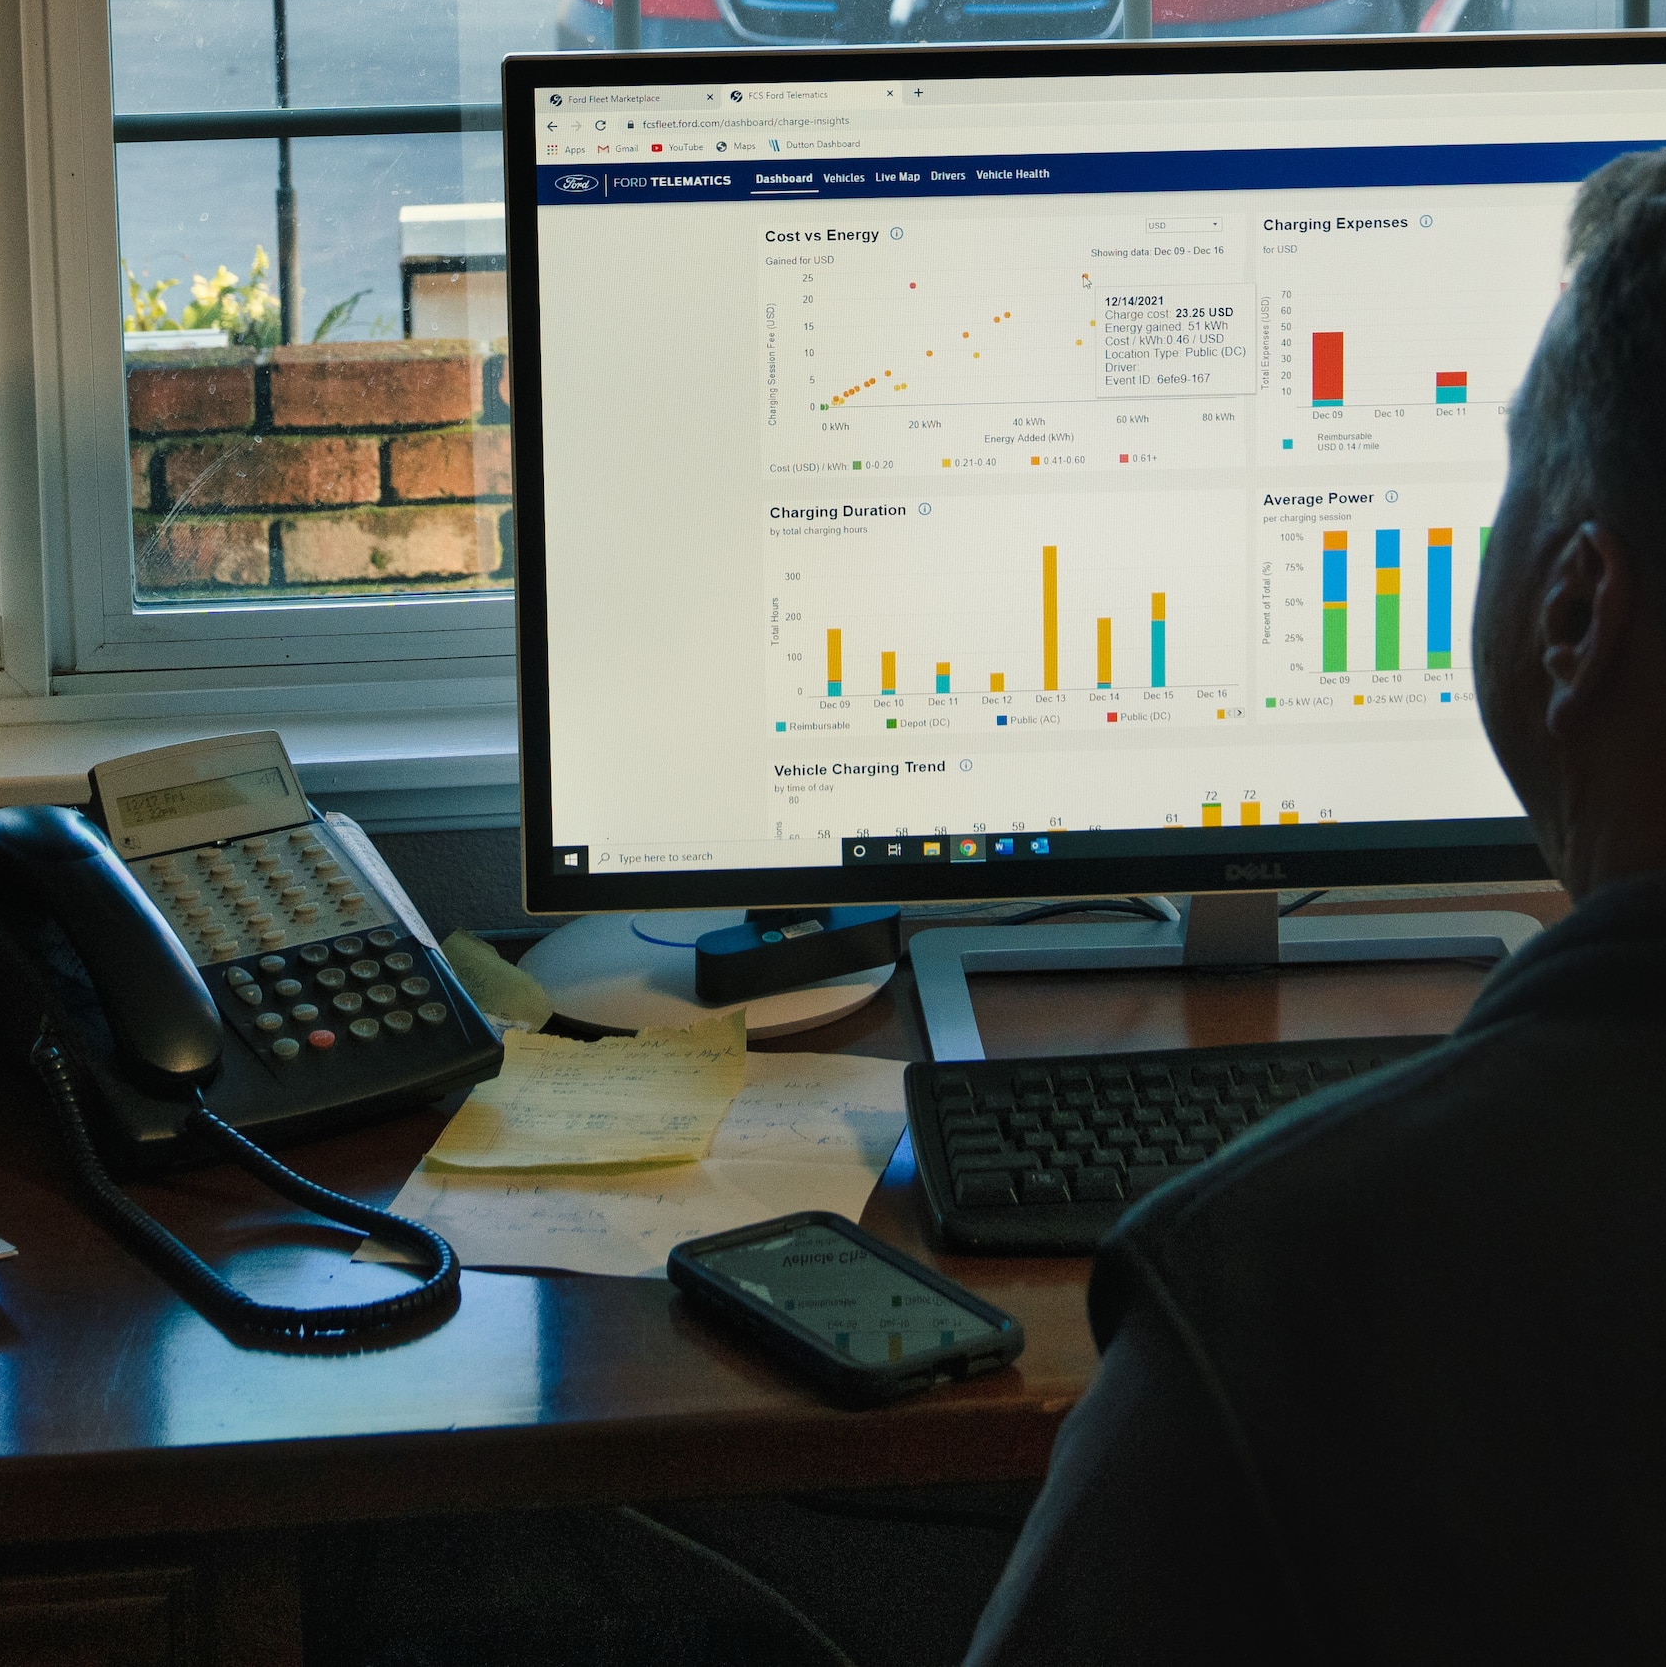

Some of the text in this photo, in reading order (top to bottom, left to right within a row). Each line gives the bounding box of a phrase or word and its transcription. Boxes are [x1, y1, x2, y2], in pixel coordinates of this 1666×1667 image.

[568, 94, 660, 104] Ford Fleet Marketplace
[749, 90, 828, 99] FCS Ford Telematics
[643, 116, 850, 129] fcsfleet.ford.com/dashboard/charge-insights
[615, 144, 639, 152] Gmail
[669, 143, 703, 151] YouTube
[733, 142, 756, 152] Maps
[786, 140, 860, 149] Dutton Dashboard
[565, 146, 586, 156] Apps
[756, 173, 813, 184] Dashboard
[823, 172, 865, 182] Vehicles
[875, 172, 921, 184] Live Map
[930, 170, 966, 180] Drivers
[976, 168, 1050, 179] Vehicle Health
[562, 176, 590, 191] Ford
[614, 176, 731, 187] FORD TELEMATICS
[1263, 217, 1408, 232] Charging Expenses
[765, 228, 879, 244] Cost vs Energy
[1263, 245, 1298, 254] for USD
[766, 255, 834, 266] Gained for USD
[1105, 296, 1164, 307] 12/14/2021
[1105, 309, 1143, 321] Charge
[1176, 308, 1205, 318] 23.25
[1209, 307, 1233, 318] USD
[1105, 323, 1142, 334] Energy
[1189, 321, 1200, 332] 51
[1204, 321, 1228, 331] kWh
[1105, 349, 1149, 359] Location
[1185, 347, 1218, 358] Public
[1221, 346, 1246, 359] (DC)
[766, 303, 778, 426] Charging Session Fee (USD)
[1105, 375, 1135, 386] Event
[984, 432, 1074, 445] Energy Added (kWh)
[1317, 432, 1372, 440] Reimbursable
[954, 458, 997, 467] 0.21-0.40
[1044, 455, 1085, 465] 0.41-0.60
[1133, 454, 1157, 463] 0.61+
[866, 460, 893, 470] 0-0.20
[1263, 493, 1374, 507] Average Power
[770, 504, 906, 520] Charging Duration
[1263, 513, 1351, 523] per charging session
[770, 525, 868, 538] by total charging hours
[1279, 696, 1333, 707] 0-5 kW (AC)
[1366, 693, 1427, 704] 0-25 kW (DC)
[1010, 715, 1061, 726] Public (AC)
[1120, 712, 1171, 723] Public (DC)
[789, 721, 850, 731] Reimbursable
[900, 718, 950, 730] Depot (DC)
[774, 760, 945, 777] Vehicle Charging Trend
[618, 852, 713, 863] Type here to search
[1225, 863, 1287, 881] DELL
